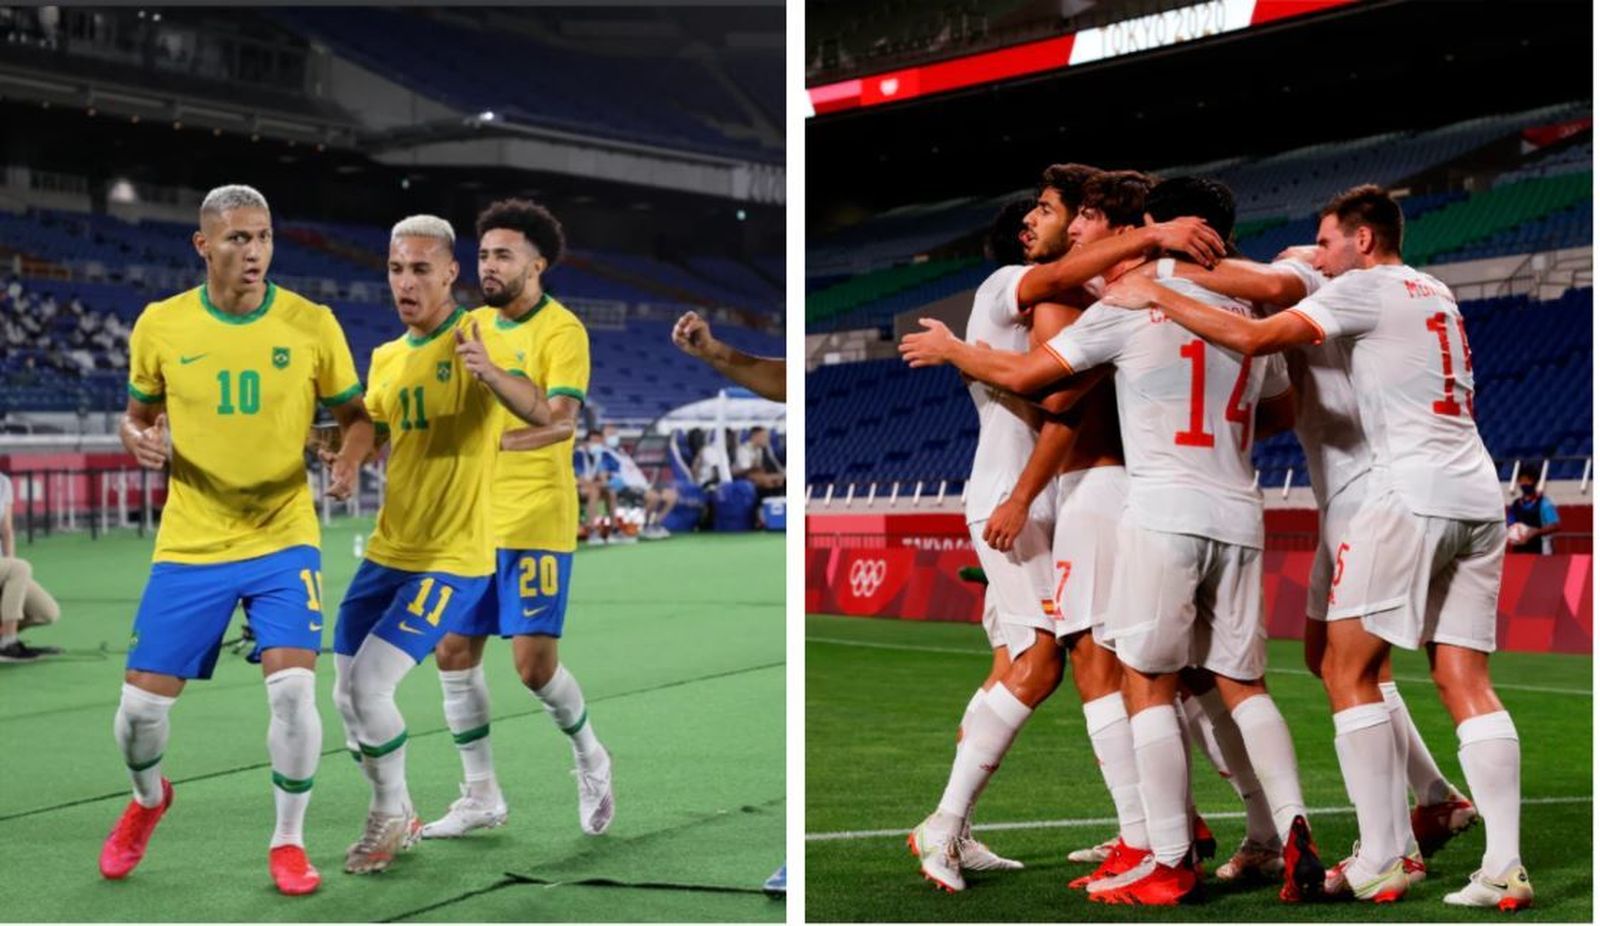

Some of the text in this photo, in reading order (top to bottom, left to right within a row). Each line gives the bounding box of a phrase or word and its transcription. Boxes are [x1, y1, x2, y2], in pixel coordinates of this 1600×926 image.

[1098, 0, 1226, 58] TOKYO 2020
[216, 369, 261, 415] 10
[399, 385, 430, 431] 11
[1174, 339, 1253, 452] 14
[519, 555, 558, 597] 20
[1056, 560, 1072, 603] 7
[407, 577, 453, 627] 11
